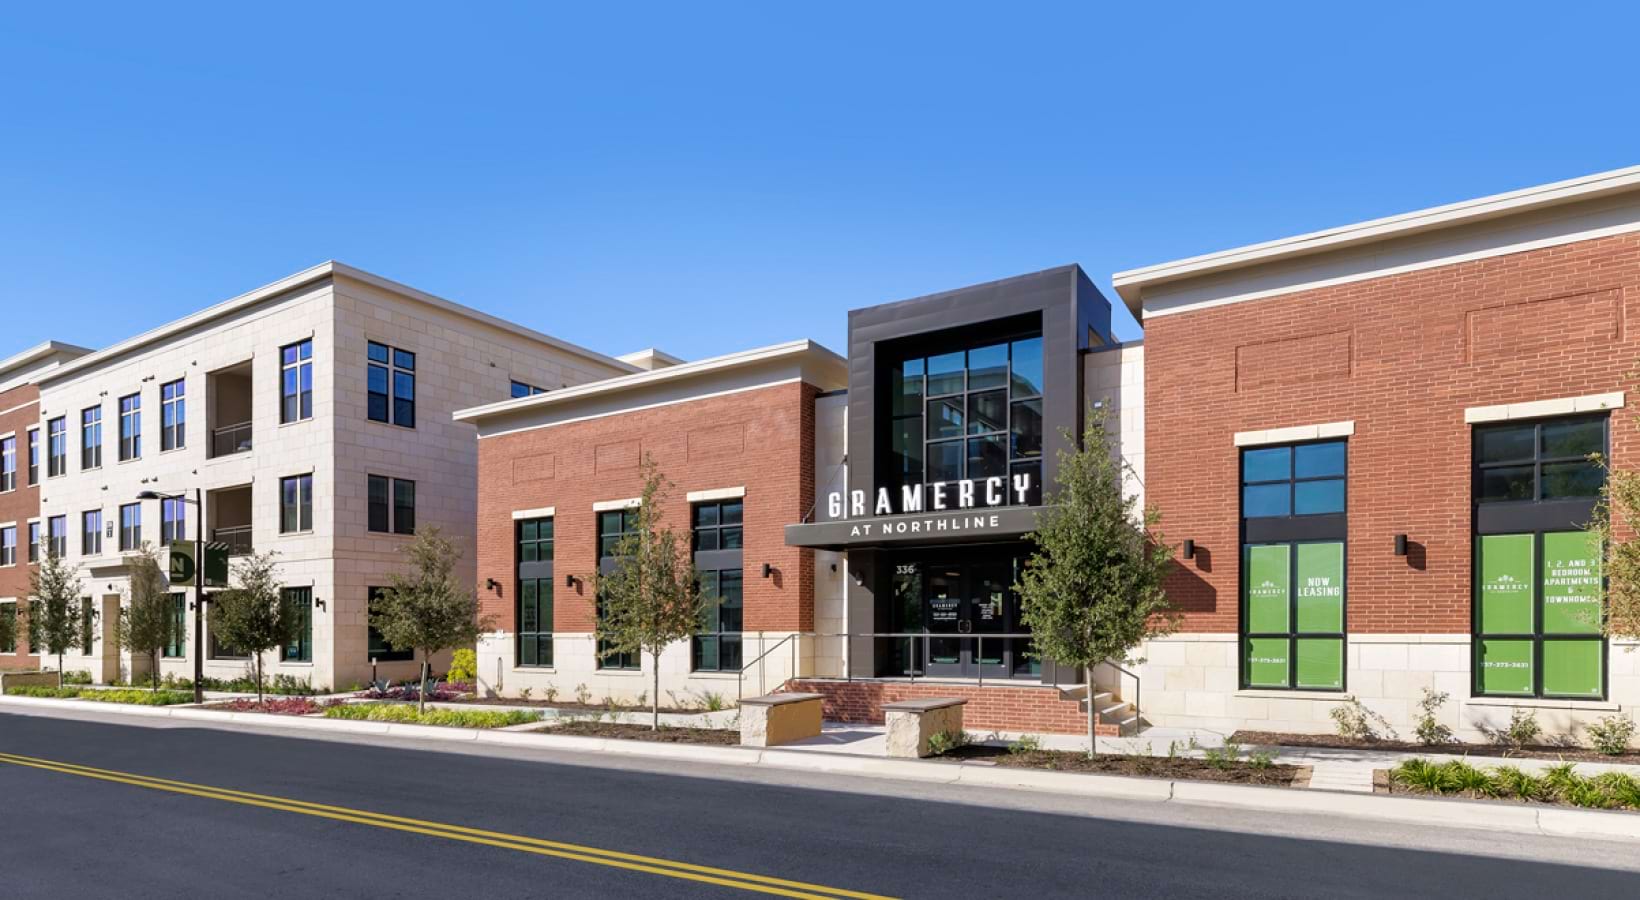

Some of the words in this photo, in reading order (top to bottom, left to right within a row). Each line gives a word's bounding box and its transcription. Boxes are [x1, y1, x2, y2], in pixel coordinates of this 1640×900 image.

[828, 473, 1030, 518] GRAMERCY
[850, 524, 872, 537] AT
[882, 515, 1000, 535] NORTHLINE
[171, 557, 184, 572] N
[1568, 559, 1586, 567] AND
[896, 565, 914, 575] 336
[1551, 568, 1591, 577] BEDROOM
[1308, 577, 1330, 587] NOW
[1544, 577, 1599, 586] APARTMENTS
[1298, 587, 1340, 597] LEASING
